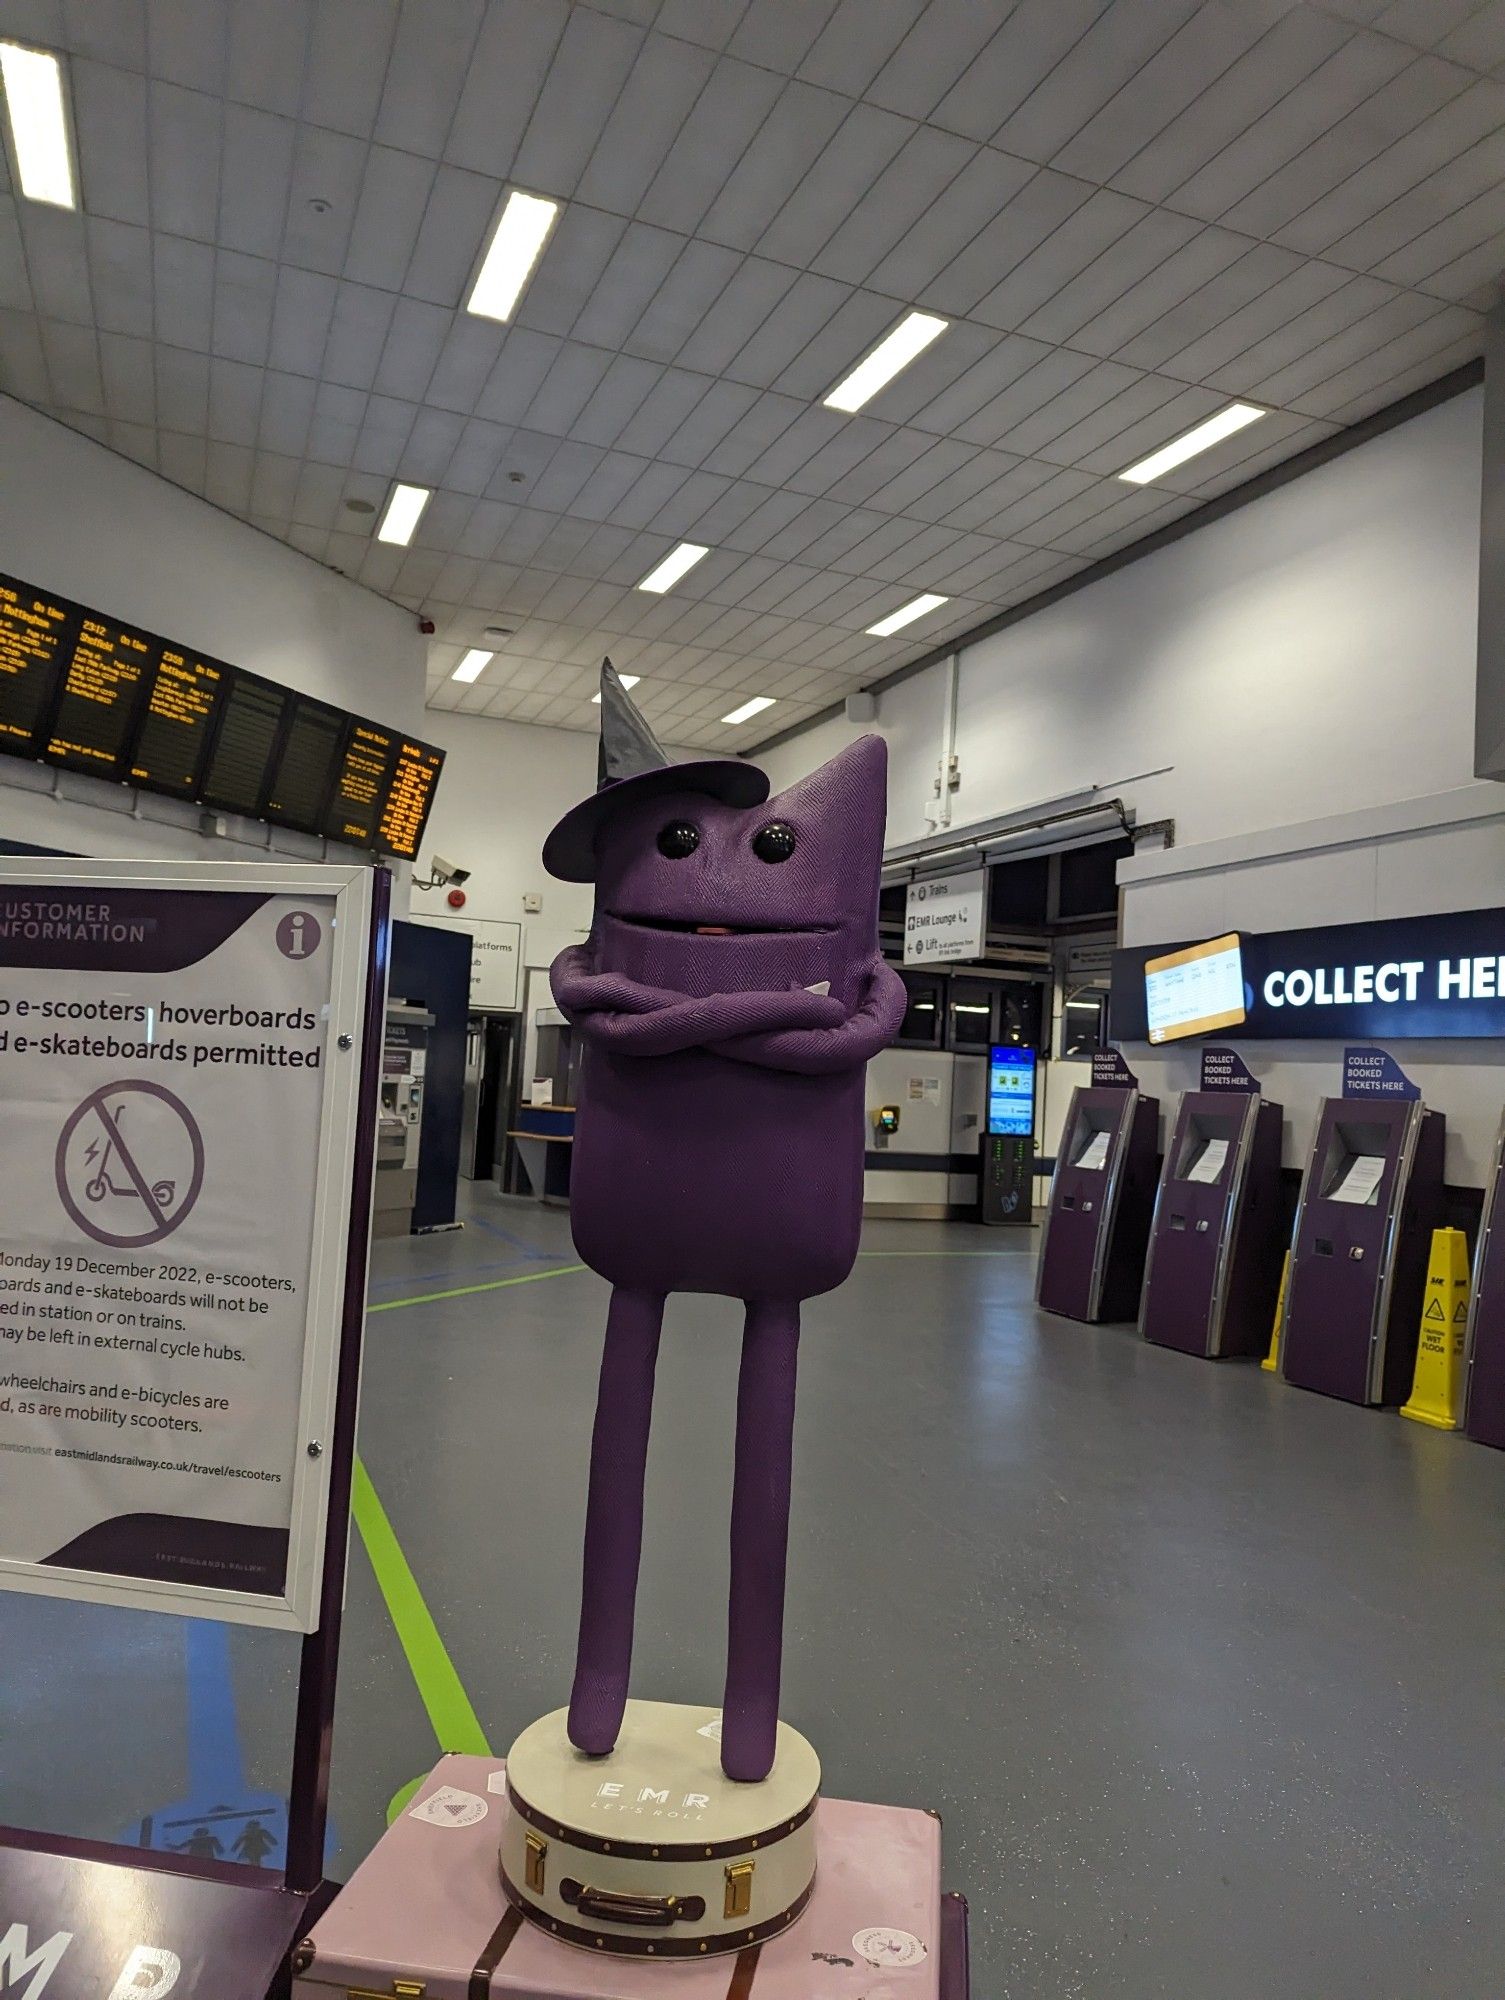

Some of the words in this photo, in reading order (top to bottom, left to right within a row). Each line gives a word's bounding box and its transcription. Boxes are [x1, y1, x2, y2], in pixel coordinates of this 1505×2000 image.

[83, 620, 106, 636] 23:12
[80, 632, 114, 652] Sheffield
[929, 884, 948, 896] Trains
[3, 902, 110, 921] USTOMER
[916, 916, 930, 928] EMR
[932, 914, 956, 926] Lounge
[0, 921, 144, 942] NFORMATION
[926, 938, 938, 950] Lift
[1264, 961, 1424, 1007] COLLECT
[0, 1000, 10, 1015] o
[159, 1001, 316, 1030] hoverboards
[0, 1031, 8, 1051] d
[14, 1032, 187, 1061] e-skateboards
[193, 1043, 320, 1068] permitted
[1094, 1054, 1117, 1062] COLLECT
[1205, 1056, 1234, 1064] COLLECT
[1348, 1057, 1386, 1066] COLLECT
[1204, 1066, 1232, 1074] BOOKED
[1348, 1068, 1382, 1078] BOOKED
[1204, 1076, 1230, 1084] TICKETS
[1347, 1080, 1380, 1090] TICKETS
[1382, 1082, 1404, 1090] HERE
[55, 1257, 72, 1270] 19
[76, 1258, 155, 1278] December
[159, 1266, 200, 1284] 2022,
[205, 1273, 295, 1293] e-scooters,
[0, 1278, 41, 1293] oards
[44, 1282, 72, 1296] and
[75, 1284, 186, 1306] e-skateboards
[190, 1294, 214, 1308] will
[218, 1297, 244, 1312] not
[248, 1298, 268, 1313] be
[0, 1301, 18, 1315] ed
[22, 1302, 35, 1316] in
[40, 1304, 92, 1322] station
[96, 1312, 114, 1323] or
[117, 1313, 136, 1326] on
[140, 1314, 186, 1331] trains.
[26, 1326, 46, 1342] be
[49, 1328, 74, 1344] left
[78, 1331, 90, 1346] in
[94, 1335, 157, 1352] external
[160, 1342, 200, 1358] cycle
[204, 1343, 246, 1361] hubs.
[1422, 1342, 1444, 1353] FLOOR
[1427, 1335, 1441, 1344] WET
[0, 1373, 86, 1395] wheelchairs
[89, 1384, 118, 1398] and
[121, 1386, 200, 1408] e-bicycles
[204, 1397, 229, 1410] are
[0, 1398, 14, 1414] d,
[18, 1402, 35, 1414] as
[38, 1404, 62, 1417] are
[65, 1406, 127, 1428] mobility
[130, 1414, 202, 1432] scooters.
[55, 1448, 281, 1482] eastmidlandsrailway.co.uk/travel/escooters
[591, 1802, 644, 1814] LET'S
[653, 1810, 704, 1820] ROLL
